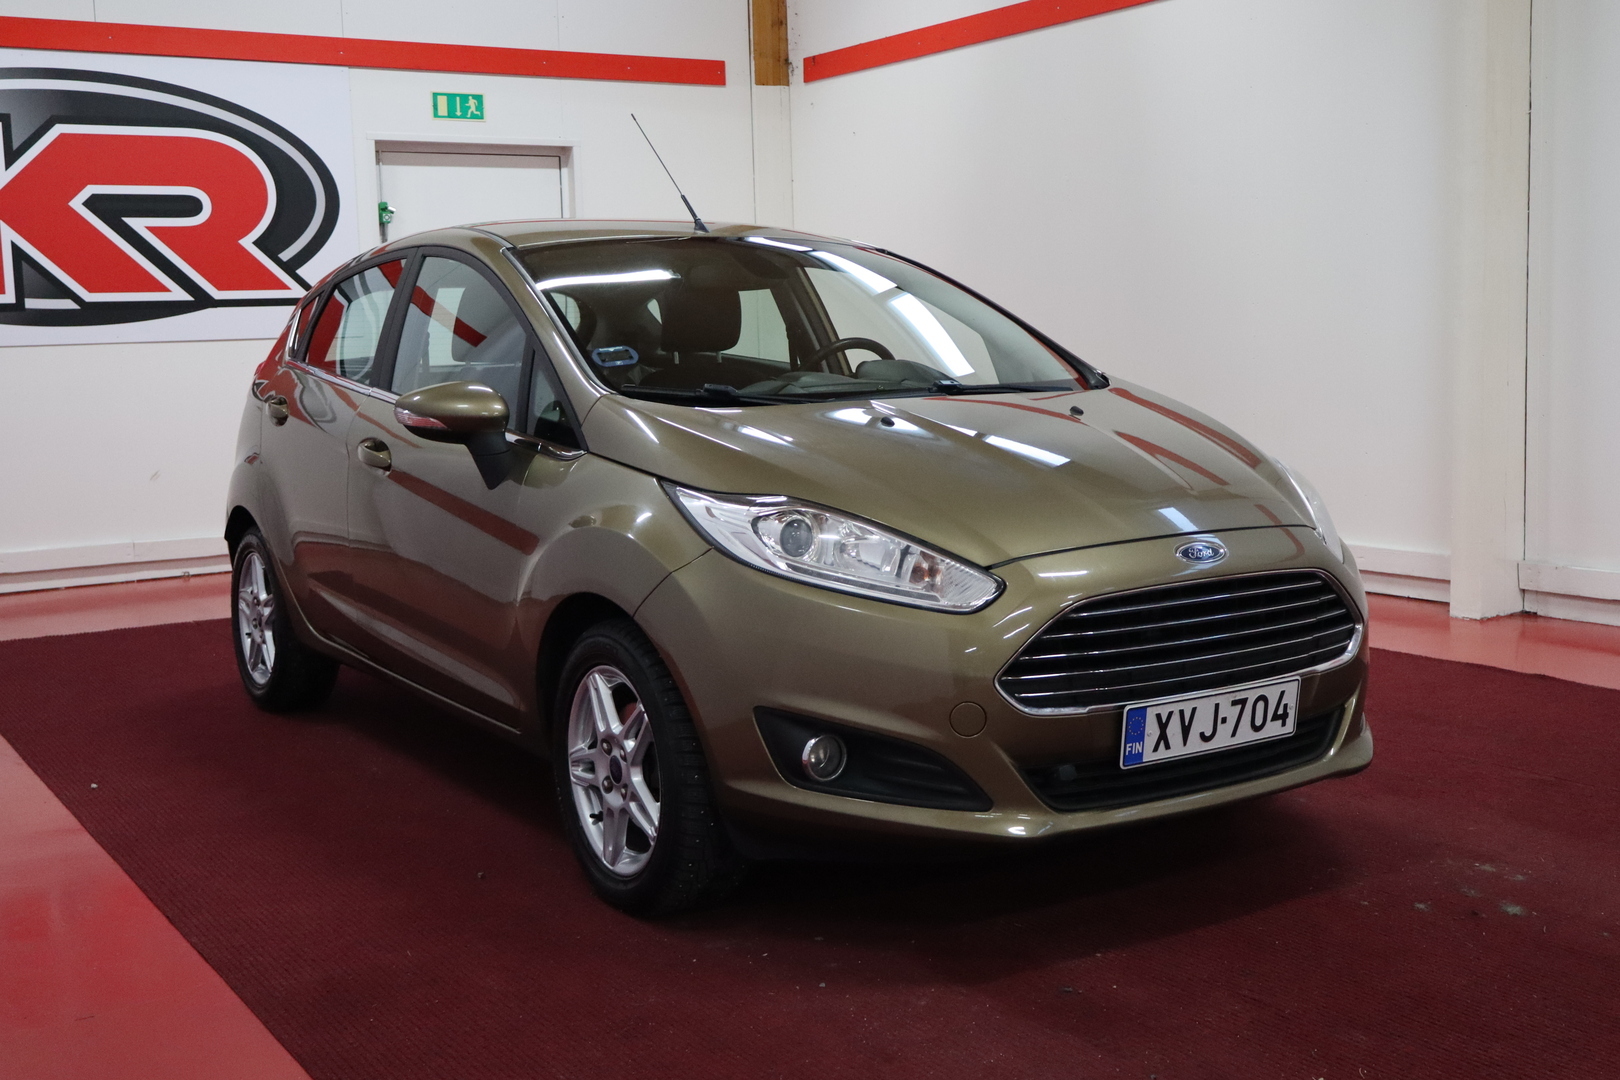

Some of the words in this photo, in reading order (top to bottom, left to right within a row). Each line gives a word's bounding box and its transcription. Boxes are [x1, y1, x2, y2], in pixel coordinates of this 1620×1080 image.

[1188, 547, 1214, 559] Ford
[1152, 690, 1289, 753] XVJ-704
[1125, 741, 1143, 756] FIN
